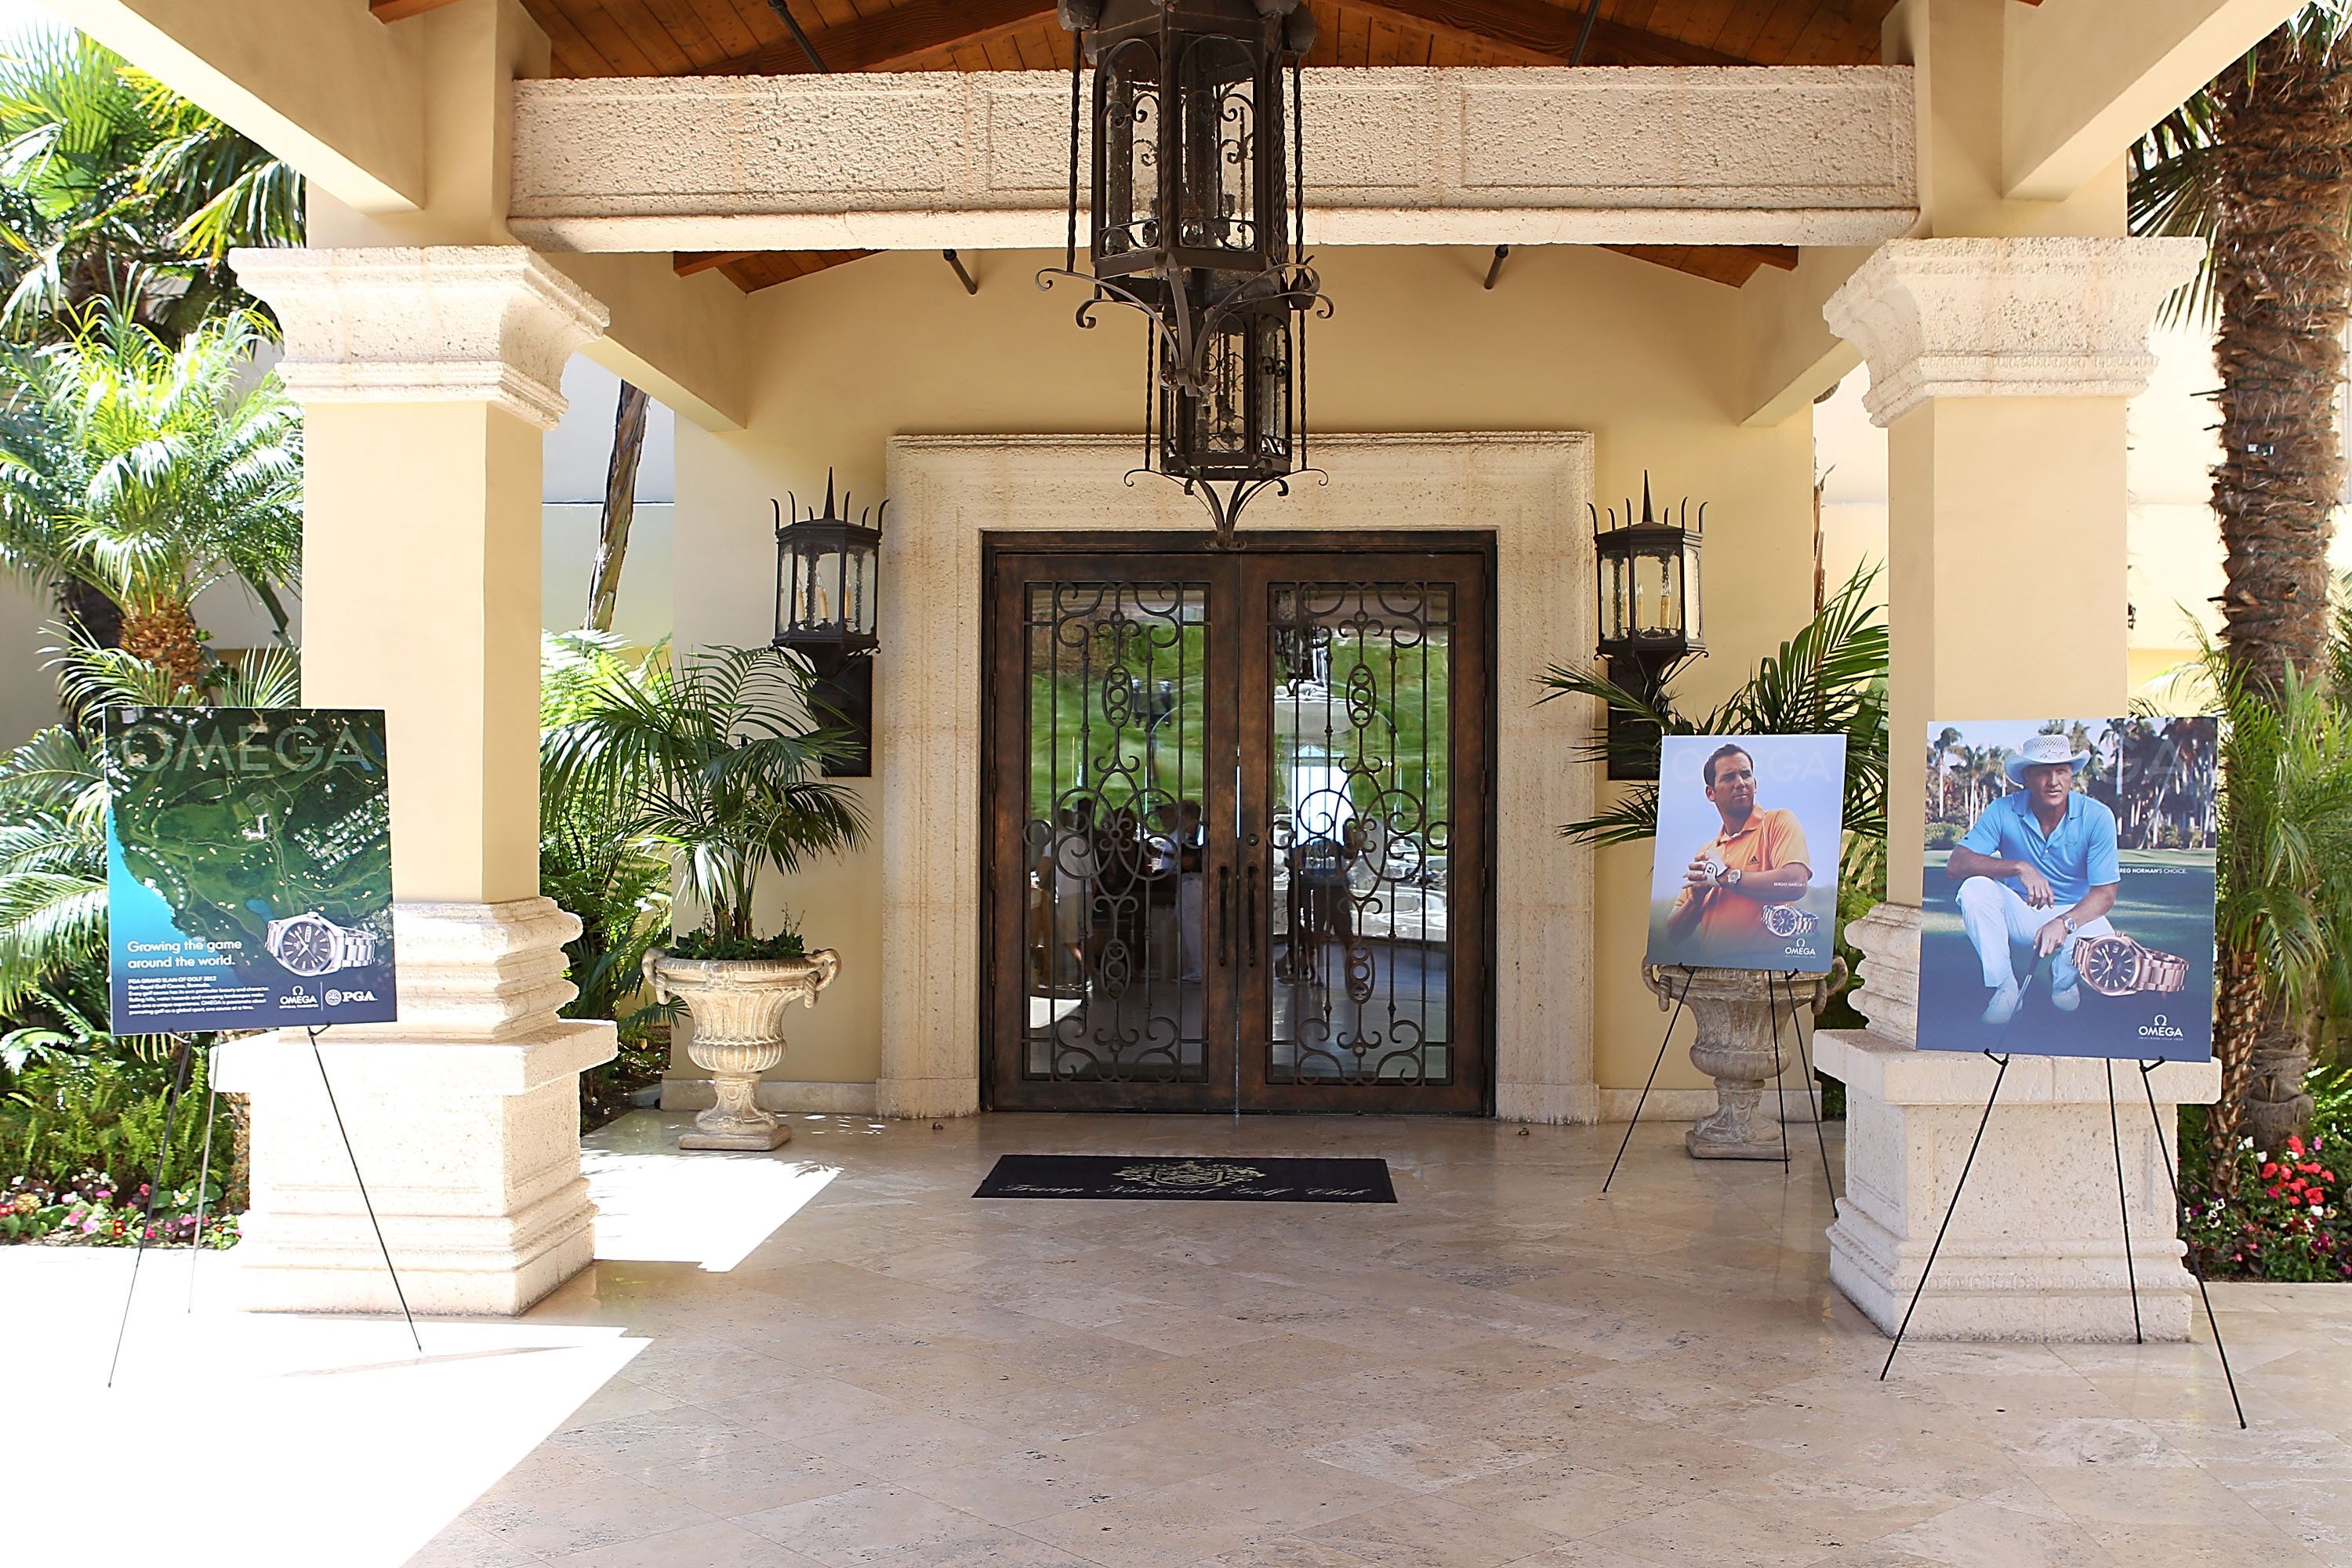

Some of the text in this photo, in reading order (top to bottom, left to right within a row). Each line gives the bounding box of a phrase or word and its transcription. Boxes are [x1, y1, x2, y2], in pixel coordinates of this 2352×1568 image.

[121, 724, 374, 771] OMEGA
[127, 939, 242, 954] Growing the game
[1784, 946, 1817, 956] OMEGA
[127, 953, 235, 969] around the world.
[279, 995, 318, 1004] OMEGA
[342, 990, 378, 1003] PGA
[2138, 1025, 2183, 1037] OMEGA
